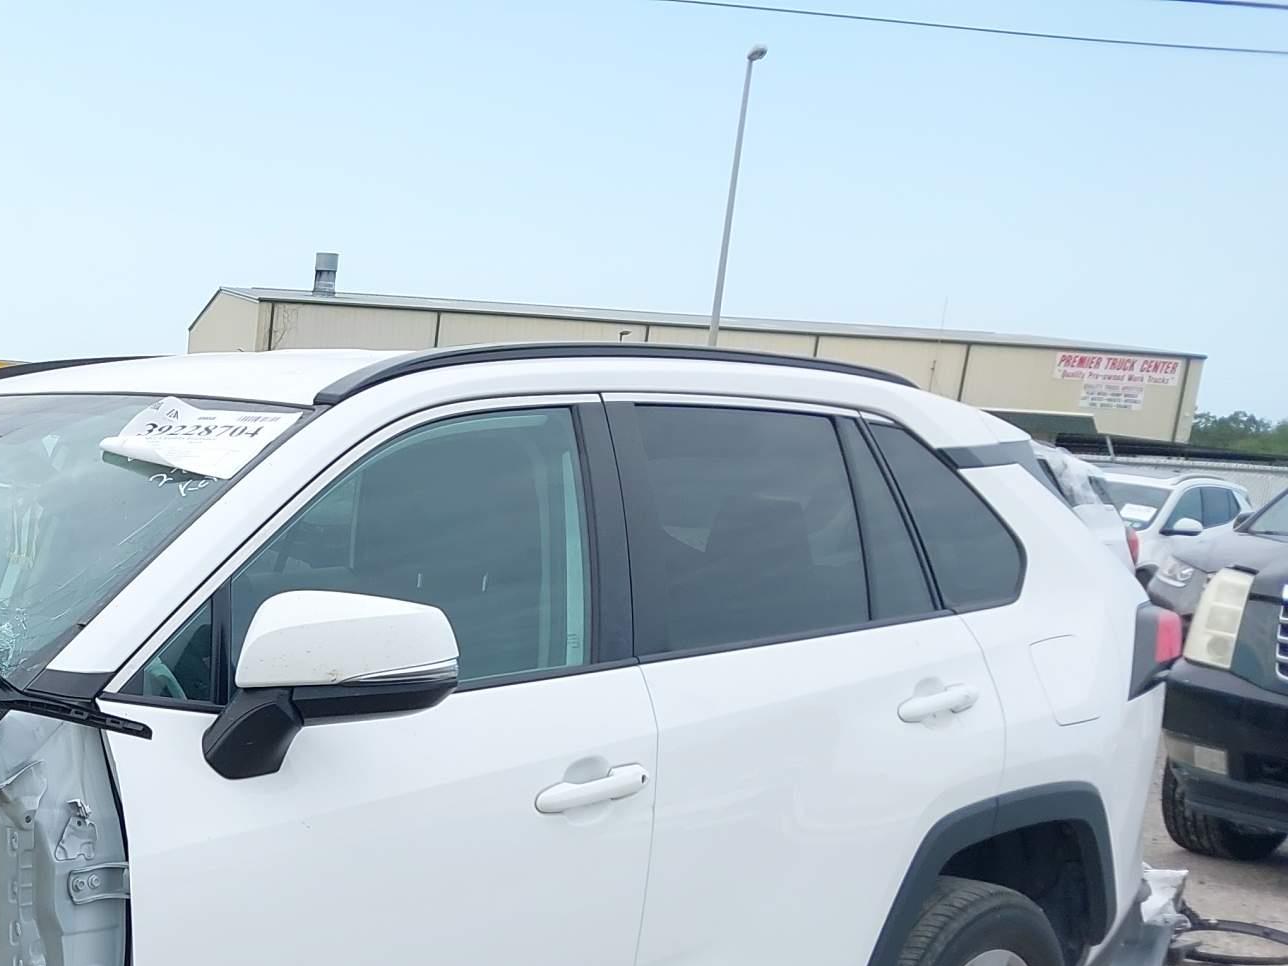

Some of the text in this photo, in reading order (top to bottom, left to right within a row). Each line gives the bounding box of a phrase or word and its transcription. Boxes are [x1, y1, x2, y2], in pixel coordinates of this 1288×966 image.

[1058, 354, 1179, 374] PREMIER TRUCK CENTER
[136, 422, 265, 438] 39228704
